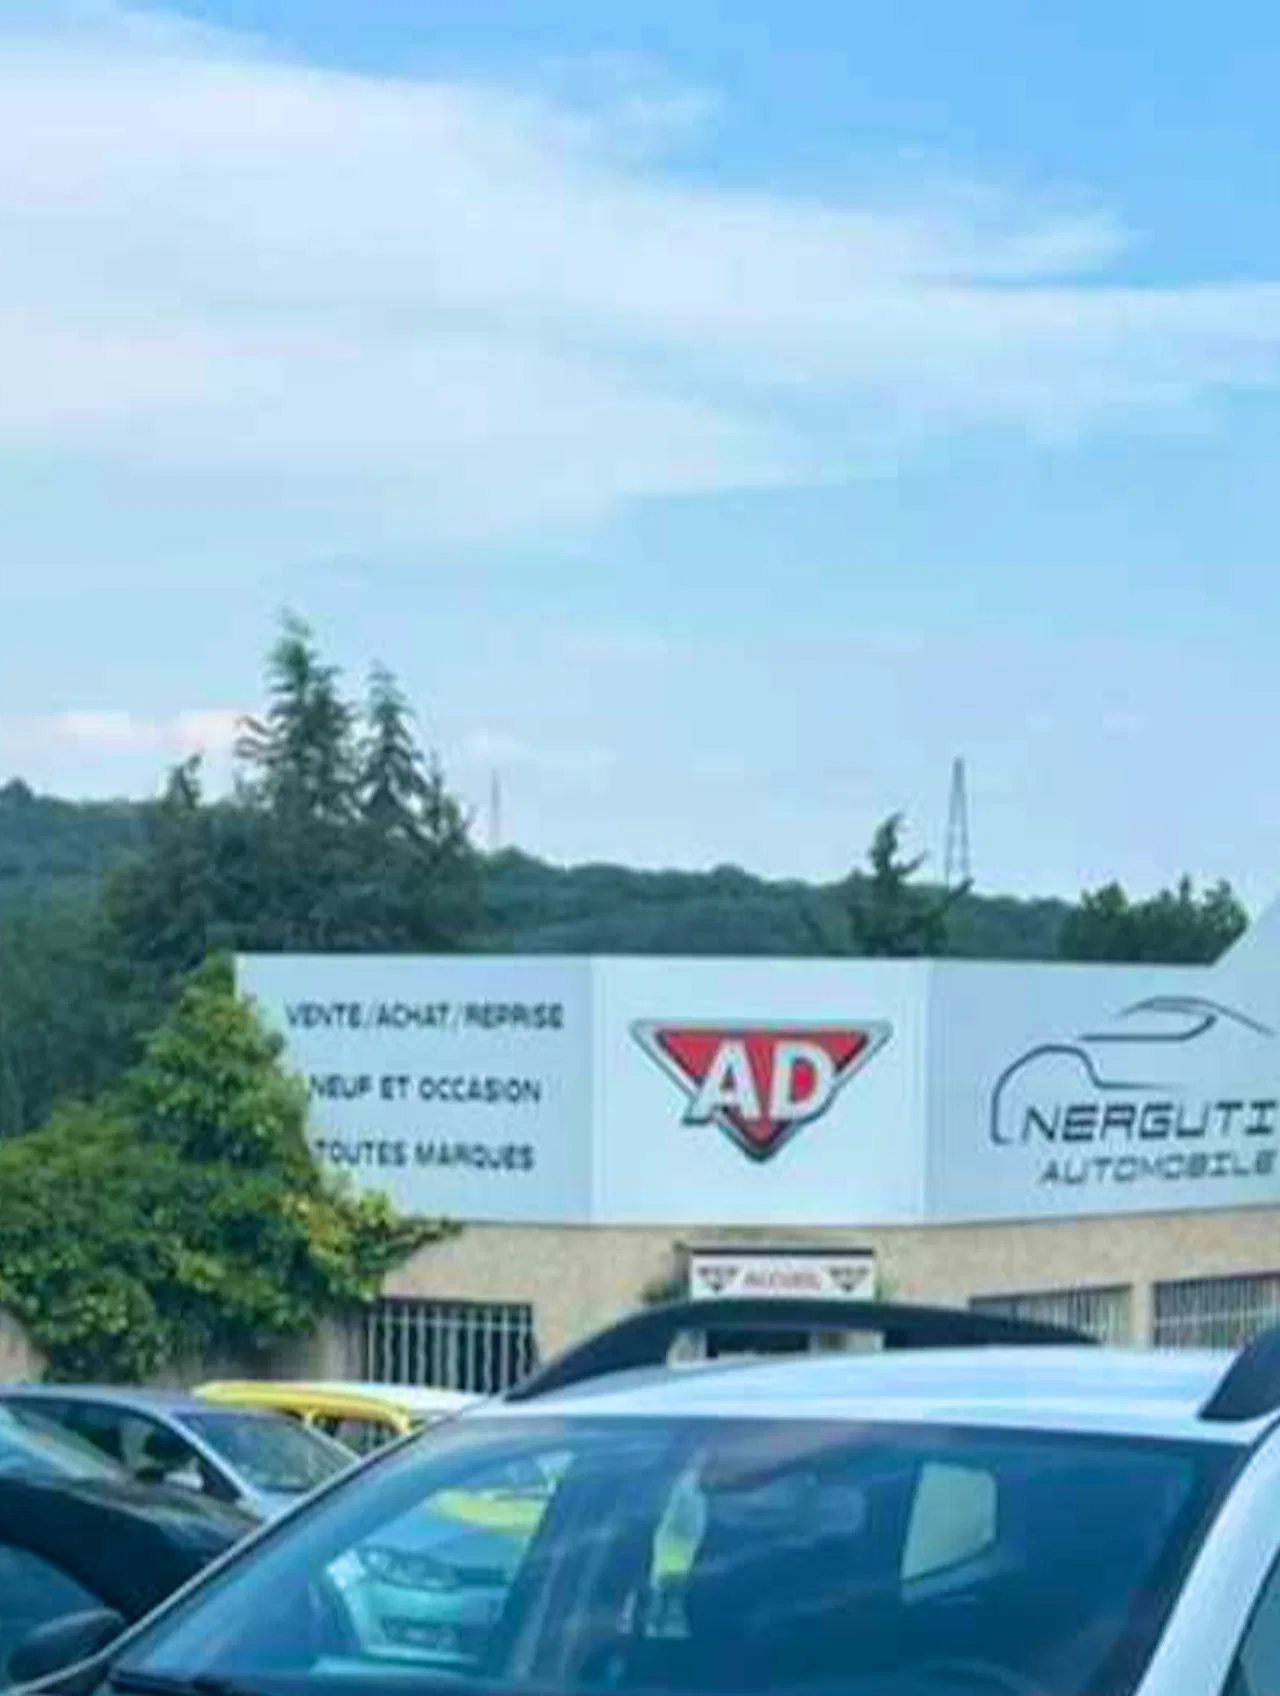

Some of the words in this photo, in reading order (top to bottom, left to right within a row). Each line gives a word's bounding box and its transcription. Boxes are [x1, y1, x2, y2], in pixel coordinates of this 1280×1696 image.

[310, 1073, 373, 1101] NEUF
[380, 1074, 411, 1101] ET
[419, 1075, 541, 1105] OCCASION
[689, 1039, 834, 1121] AD
[1022, 1098, 1279, 1143] NERGUTI
[314, 1139, 409, 1168] TOUTES
[415, 1141, 535, 1171] MARQUES
[1037, 1149, 1279, 1187] AUTOMOBILE
